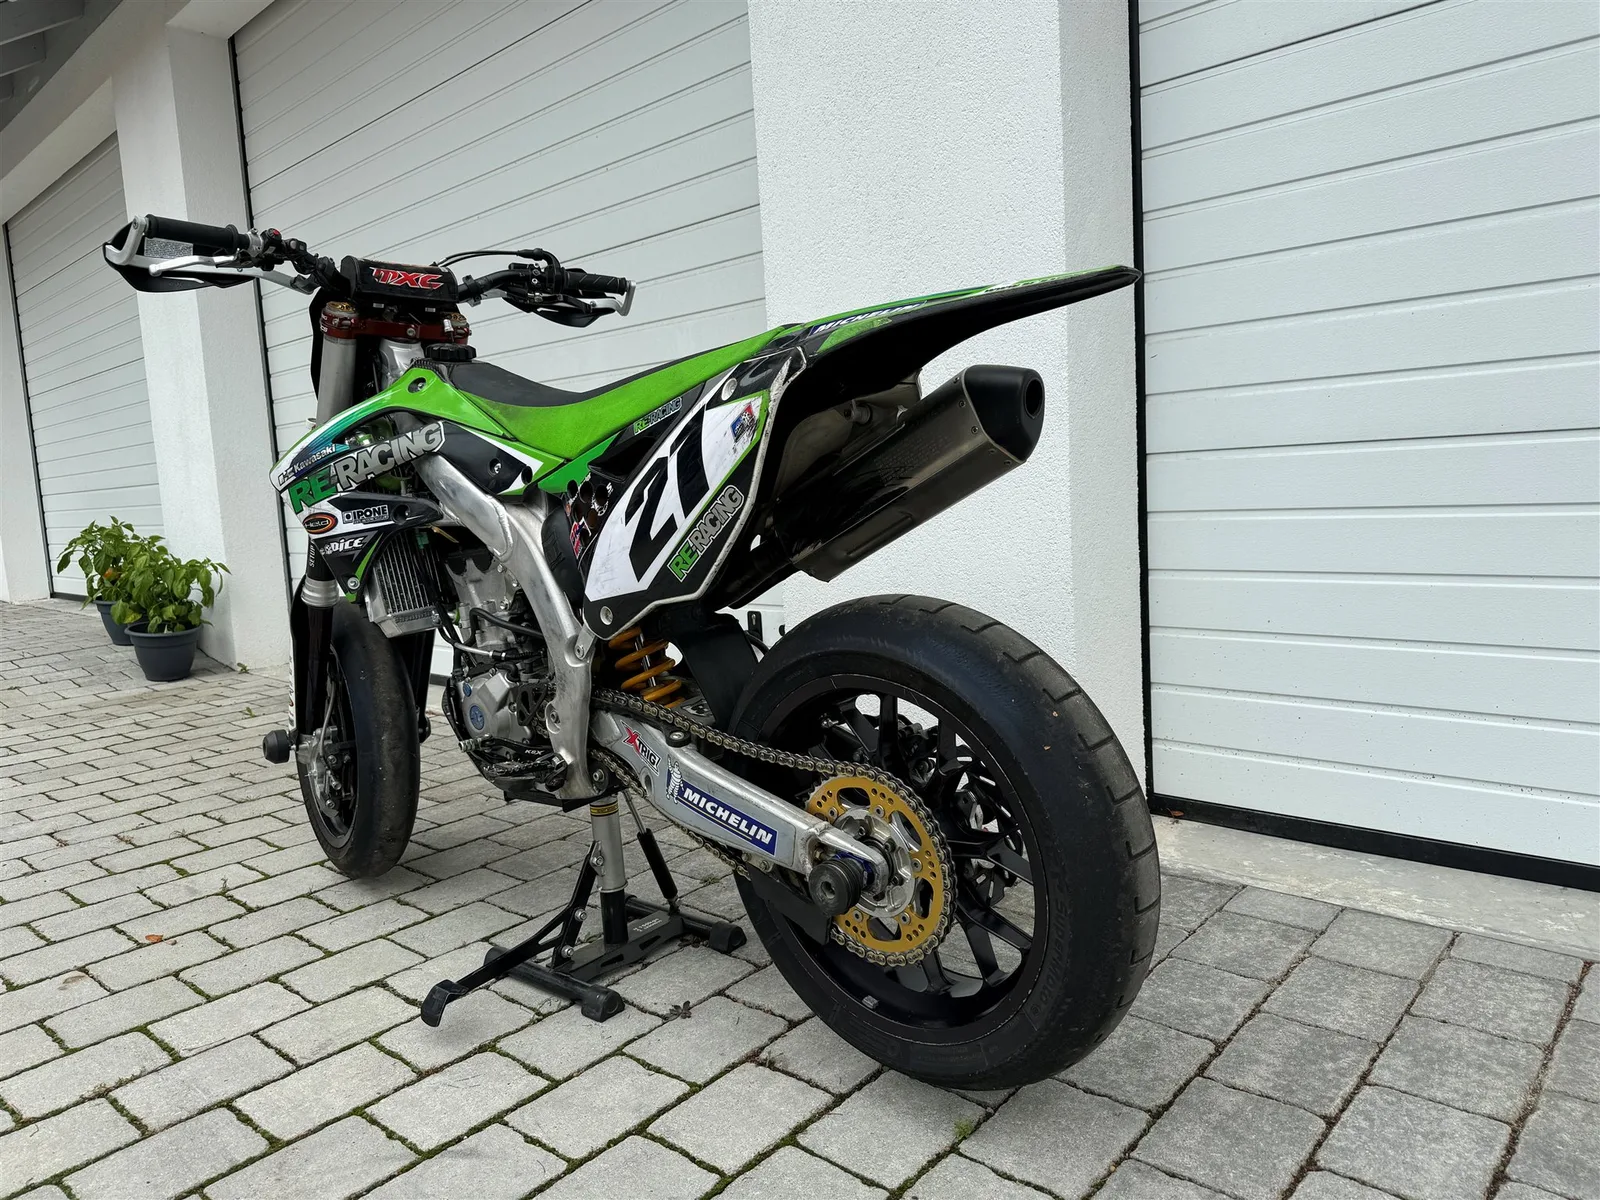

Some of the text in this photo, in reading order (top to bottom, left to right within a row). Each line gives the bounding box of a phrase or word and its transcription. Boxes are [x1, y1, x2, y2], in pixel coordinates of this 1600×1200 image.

[294, 444, 336, 473] Kawasaki
[353, 506, 388, 520] IPONE
[625, 404, 710, 583] 21
[683, 787, 772, 845] MICHELIN
